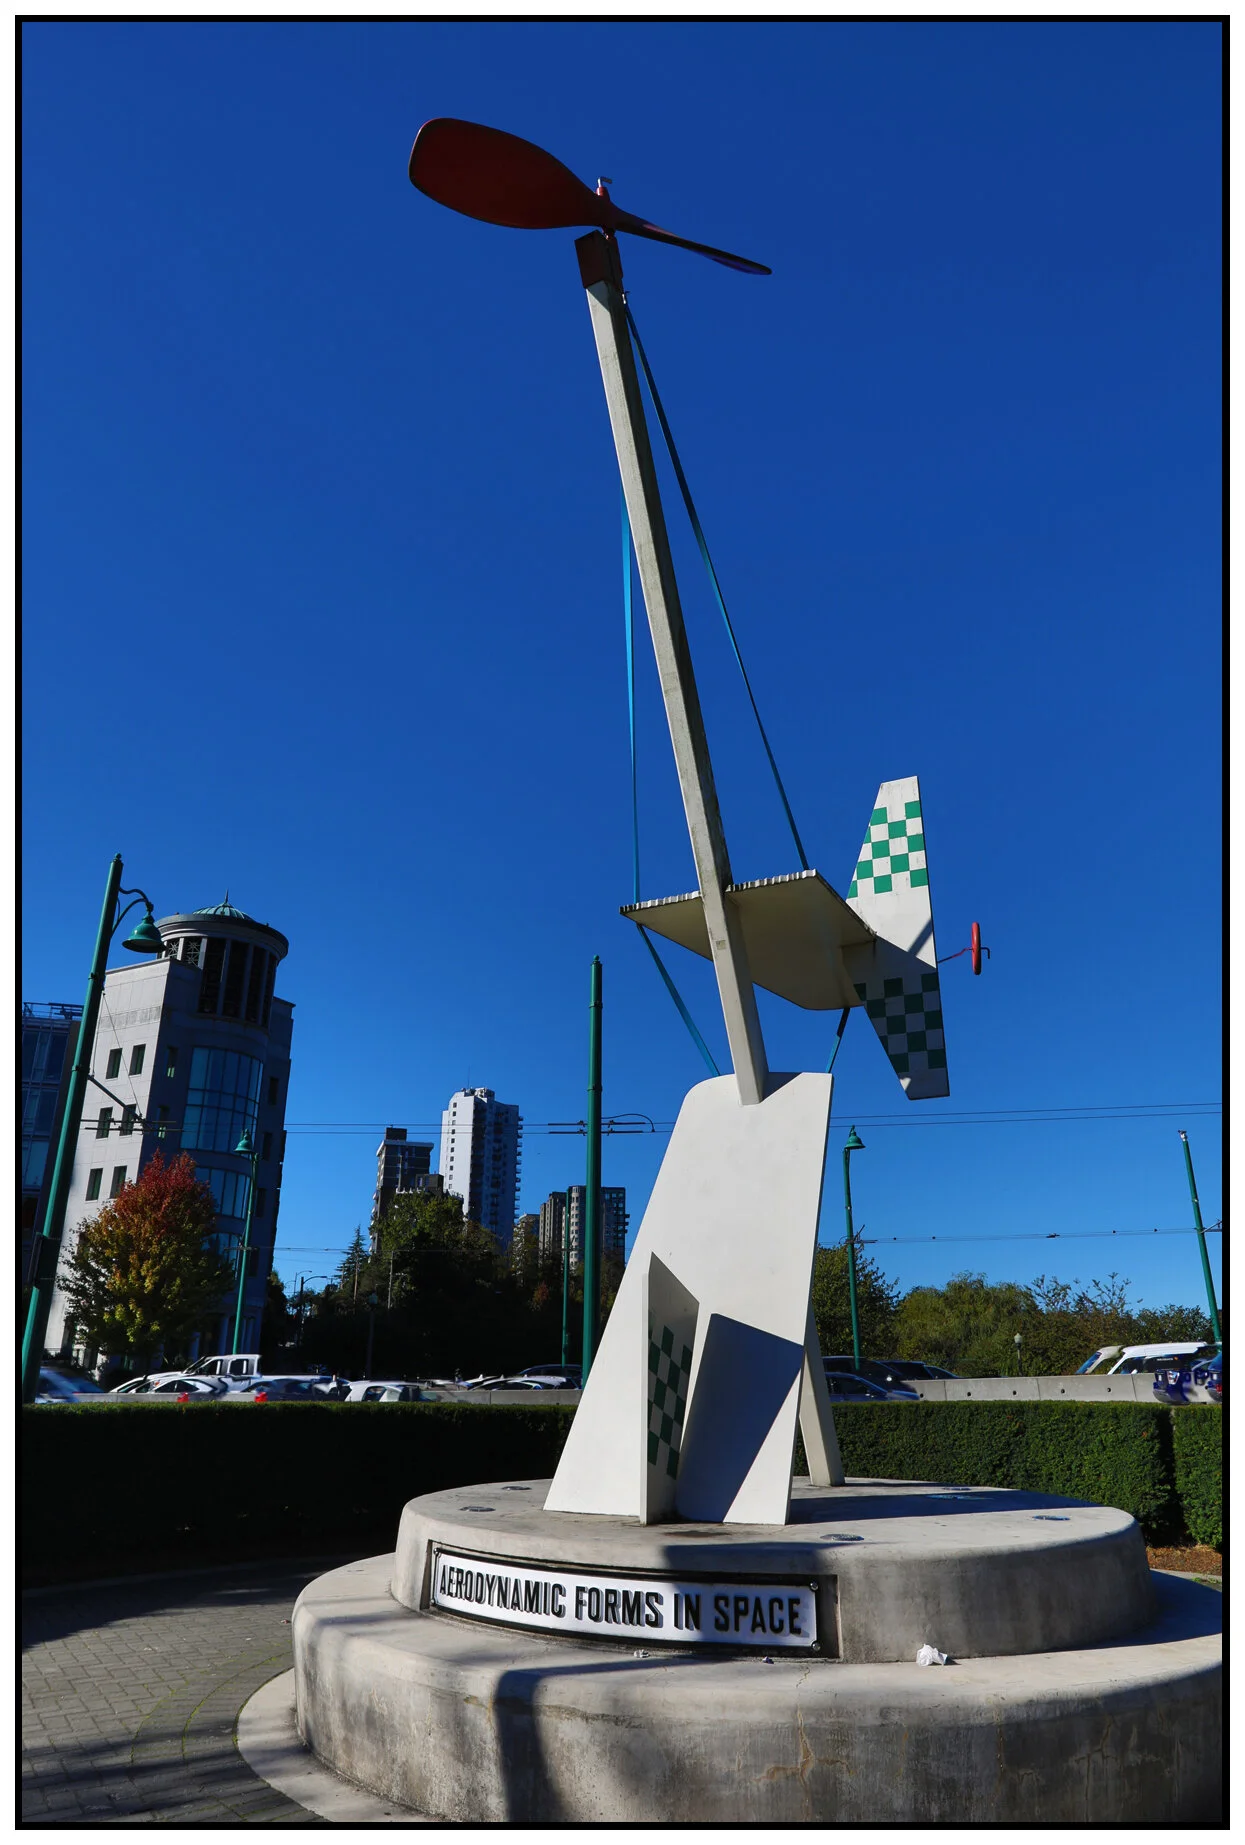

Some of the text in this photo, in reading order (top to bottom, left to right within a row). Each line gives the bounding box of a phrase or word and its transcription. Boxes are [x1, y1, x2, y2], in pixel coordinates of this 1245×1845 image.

[440, 1564, 804, 1635] AERODYNAMIC FORMS IN SPACE
